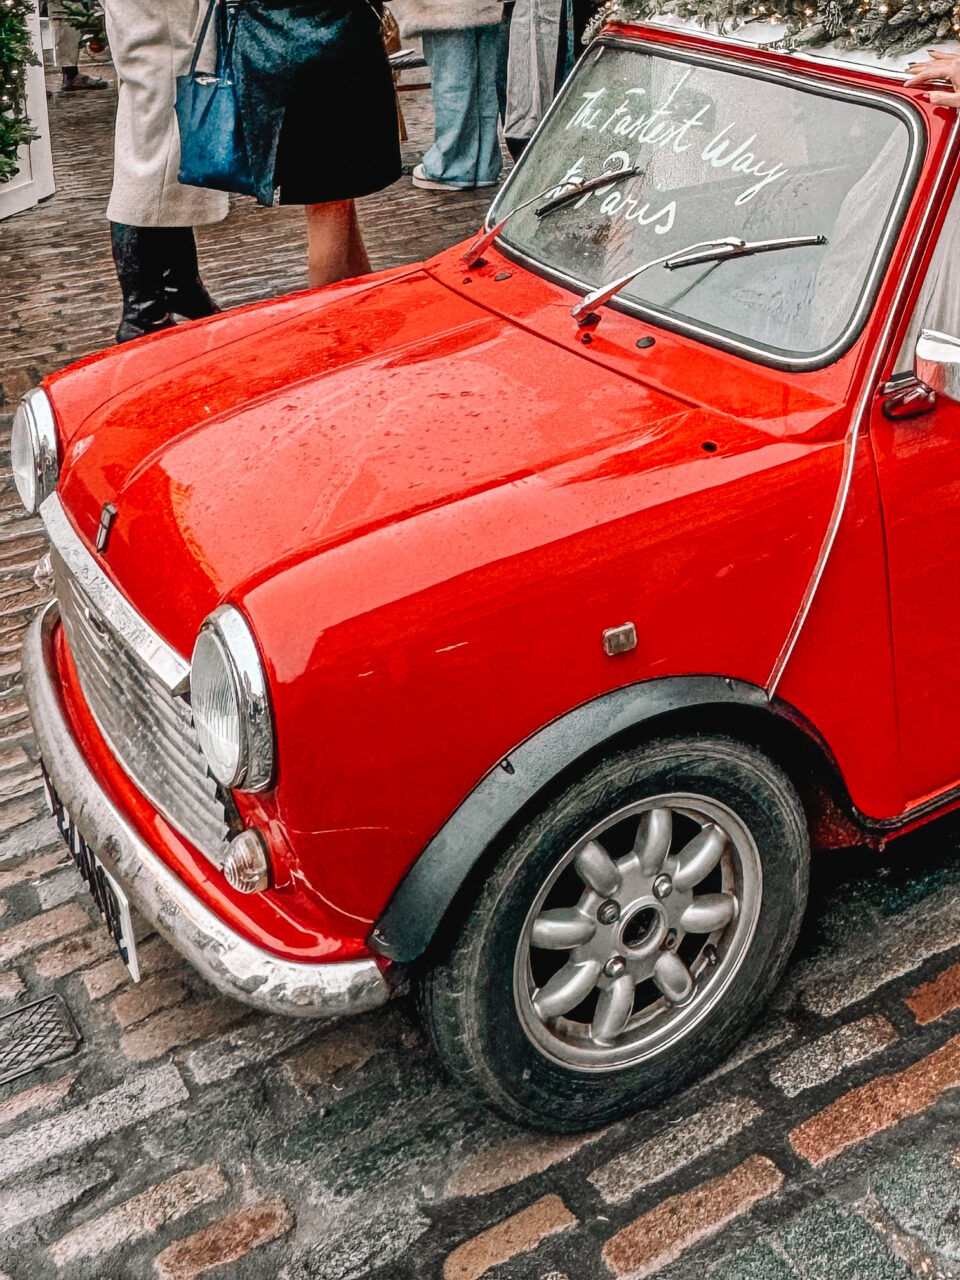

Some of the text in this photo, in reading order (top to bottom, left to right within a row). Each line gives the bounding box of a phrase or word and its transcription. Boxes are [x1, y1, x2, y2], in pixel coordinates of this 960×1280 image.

[565, 68, 790, 206] The Fastest Way
